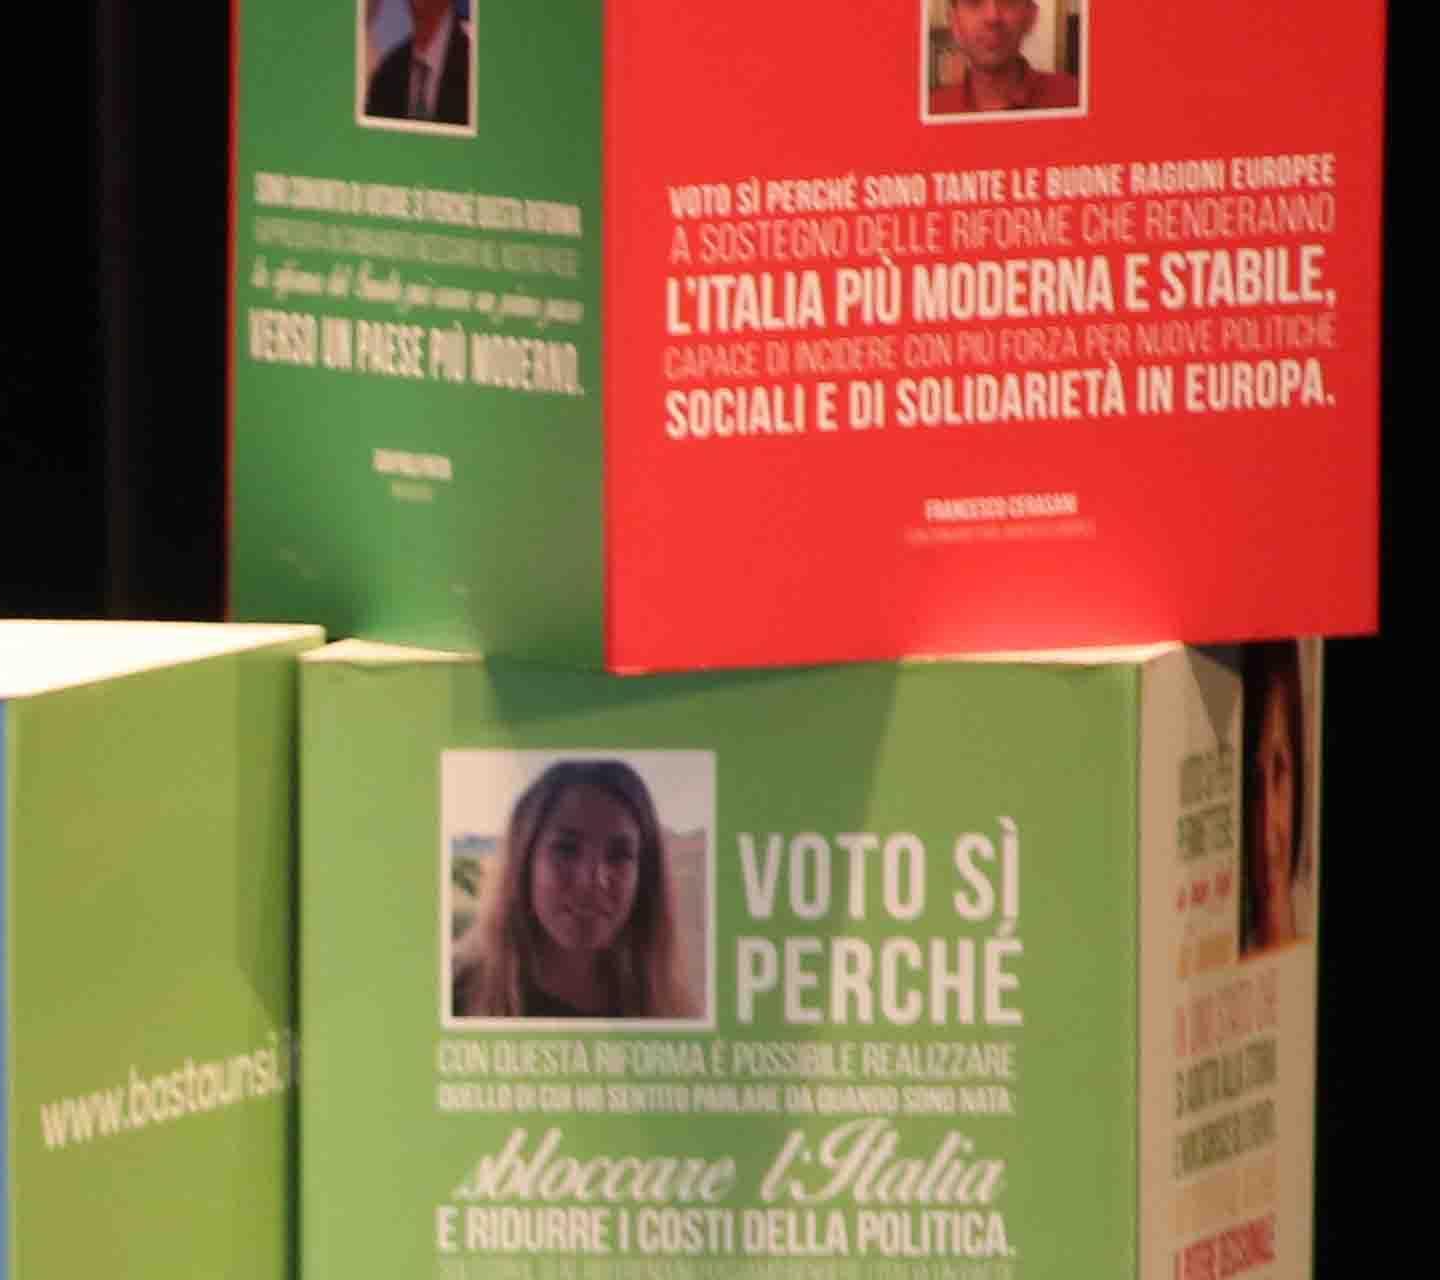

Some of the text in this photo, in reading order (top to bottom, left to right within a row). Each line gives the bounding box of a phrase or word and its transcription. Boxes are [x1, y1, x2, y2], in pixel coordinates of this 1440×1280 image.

[669, 152, 1336, 219] VOTO SÌ PERCHÉ SONO TANTE LE BUONE RAGIONI EUROPEE
[672, 192, 1336, 264] A SOSTEGNO DELLE RIFORME CHE RENDERANNO
[666, 244, 1336, 336] L'ITALIA PIÙ MODERNA E STABILE,
[664, 342, 758, 381] CAPACE
[765, 340, 789, 377] DI
[904, 333, 953, 370] CON
[1000, 326, 1078, 363] FORZA
[1084, 322, 1131, 359] PER
[1136, 317, 1212, 356] NUOVE
[1221, 311, 1336, 352] POLITICHE
[665, 356, 1336, 440] SOCIALI E DI SOLIDARIETÀ IN EUROPA.
[736, 815, 1020, 922] VOTO SÌ
[736, 918, 1025, 1025] PERCHÉ
[438, 1040, 488, 1075] CON
[494, 1040, 590, 1076] QUESTA
[594, 1040, 706, 1076] RIFORMA
[735, 1040, 857, 1076] POSSIBILE
[863, 1040, 1016, 1076] REALIZZARE
[437, 1206, 1017, 1257] E RIDURRE I COSTI DELLA POLITICA.
